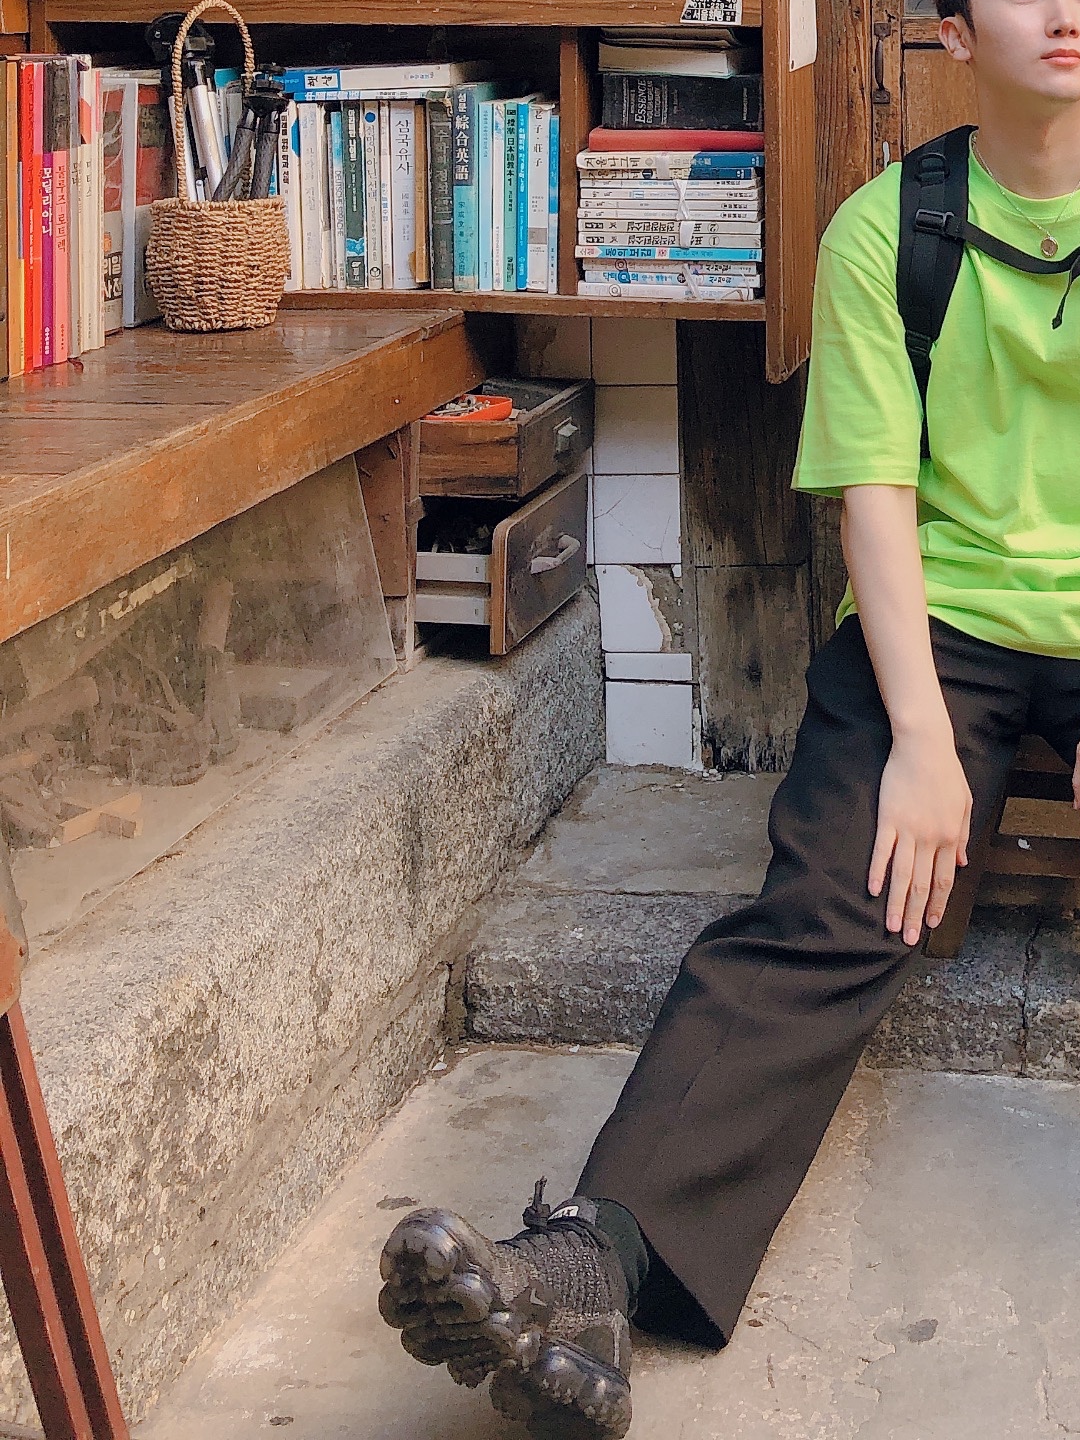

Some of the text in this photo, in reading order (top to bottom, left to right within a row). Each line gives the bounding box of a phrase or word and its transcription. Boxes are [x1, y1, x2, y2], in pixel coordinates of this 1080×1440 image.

[635, 79, 646, 123] ESSENCE
[395, 119, 413, 175] 삼국유사
[455, 115, 470, 181] 綜合英語
[42, 167, 53, 237] 모딜리아니
[605, 248, 652, 257] 동의보감
